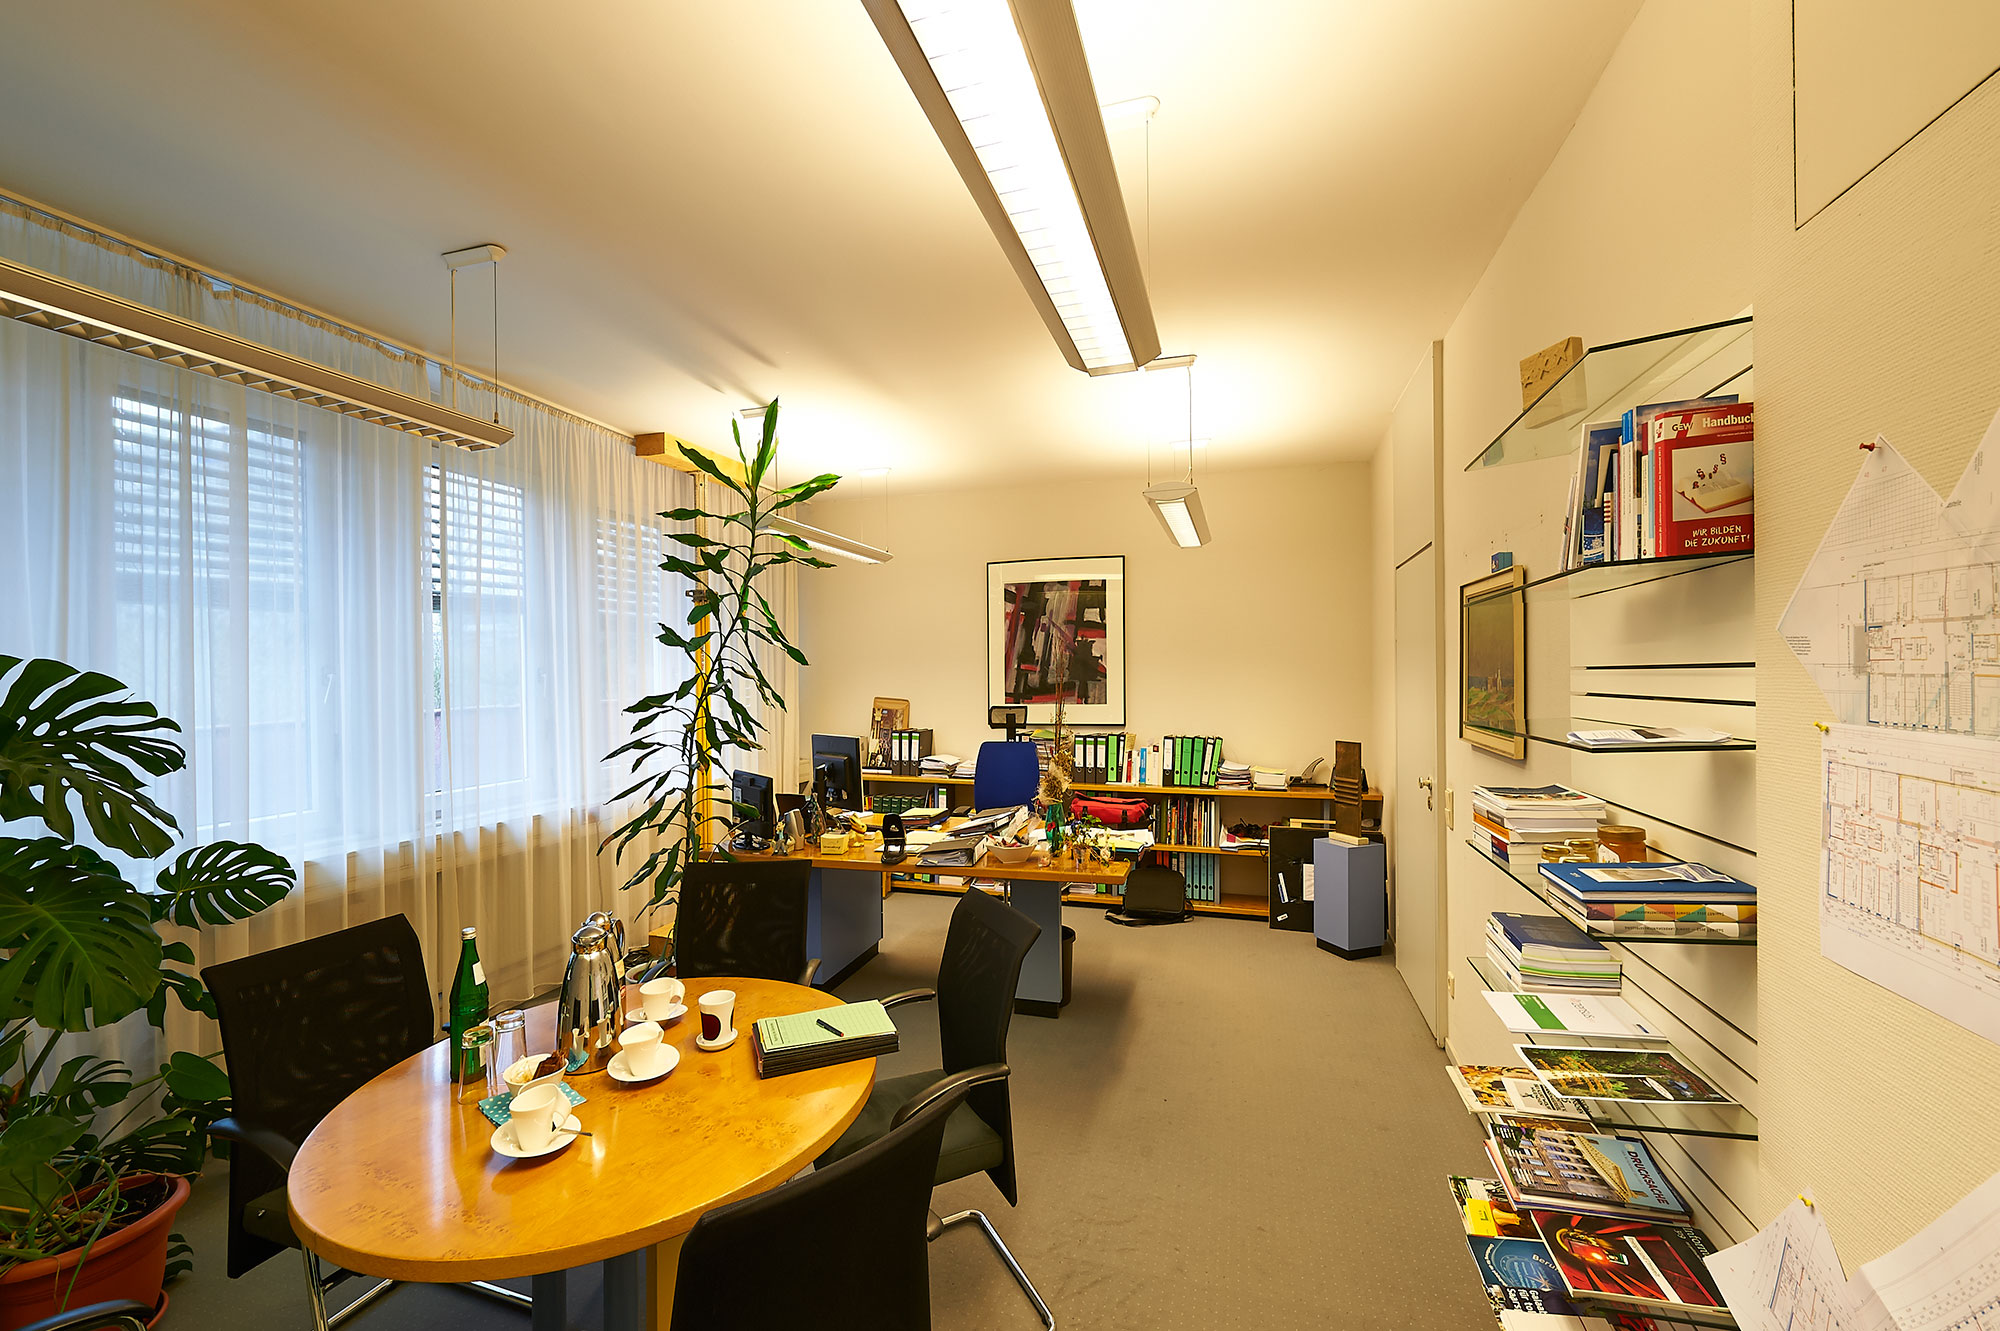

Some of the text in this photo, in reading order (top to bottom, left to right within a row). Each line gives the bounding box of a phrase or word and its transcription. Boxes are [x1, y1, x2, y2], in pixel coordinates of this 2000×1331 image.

[1692, 524, 1742, 538] WIR BILDEN
[1684, 533, 1750, 548] DIE ZUKUNFT!
[1627, 1150, 1670, 1206] DRUCKSACHE
